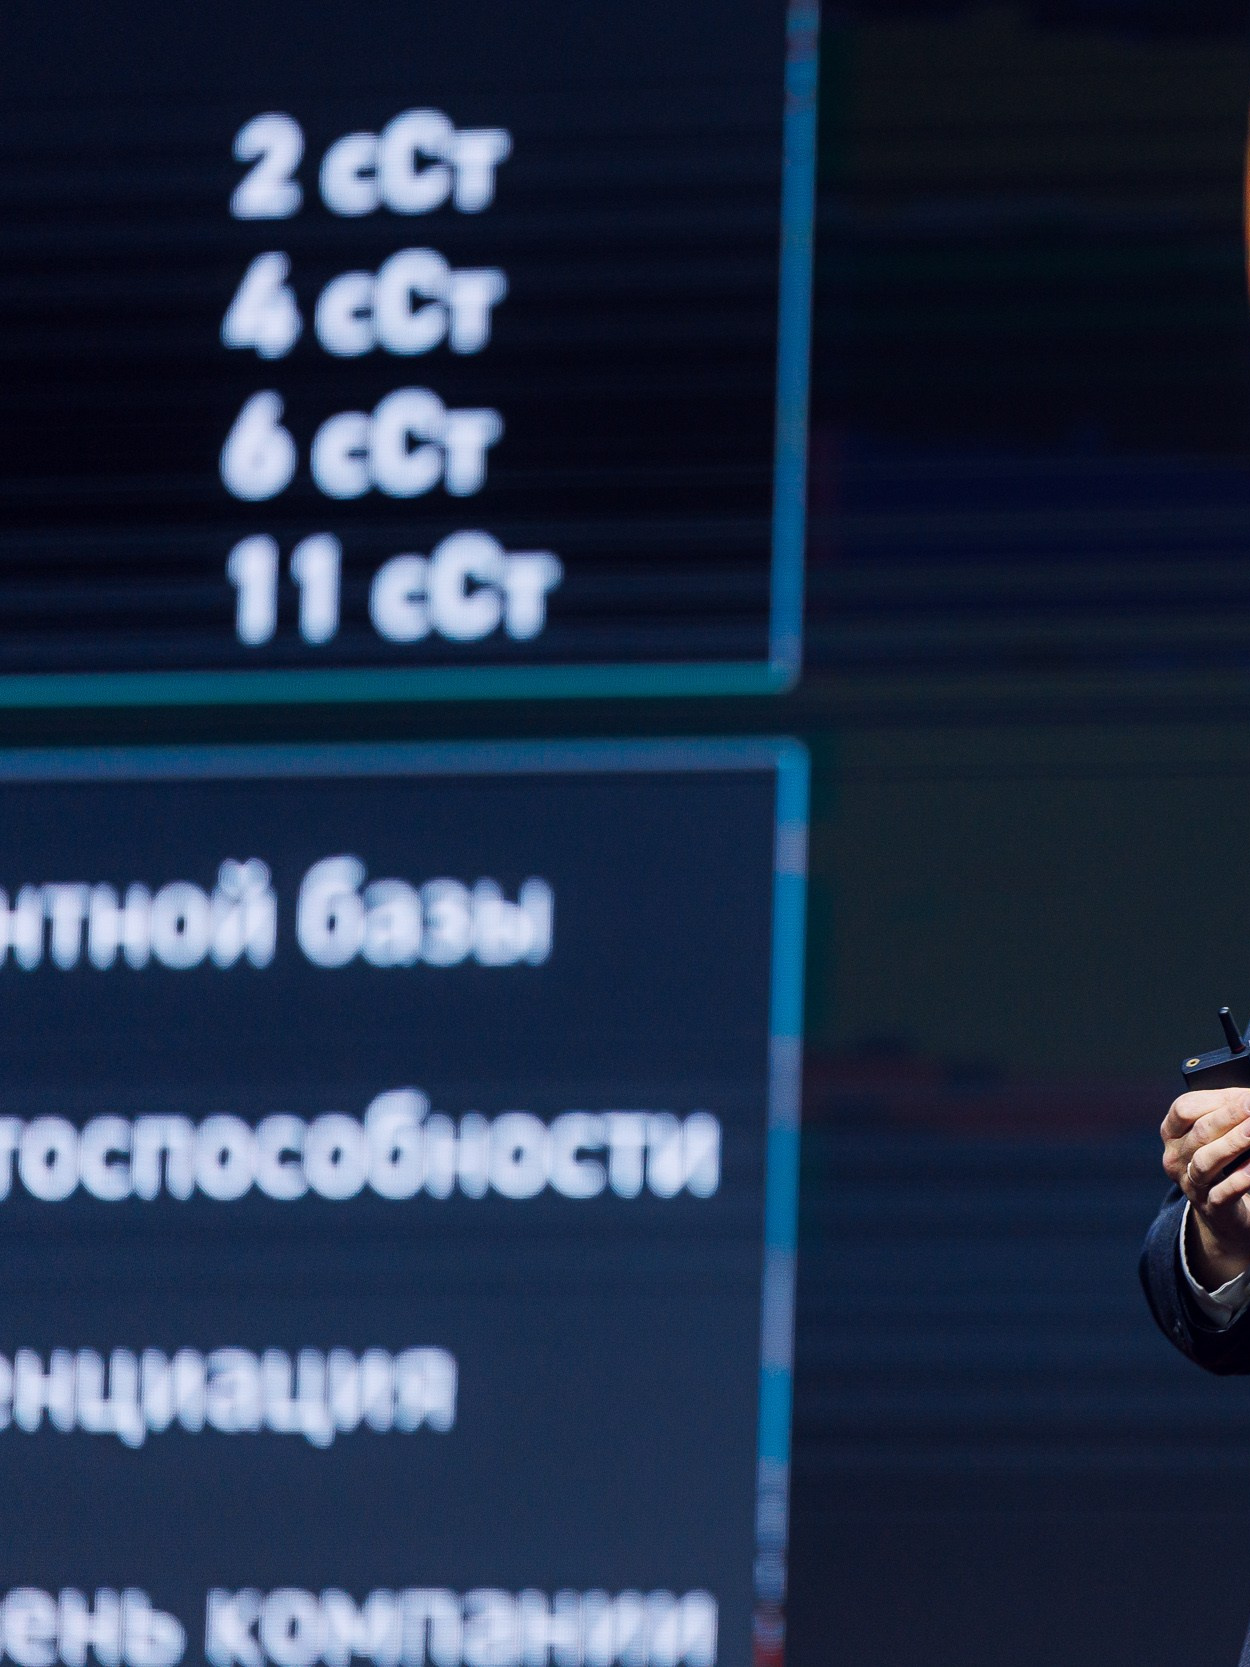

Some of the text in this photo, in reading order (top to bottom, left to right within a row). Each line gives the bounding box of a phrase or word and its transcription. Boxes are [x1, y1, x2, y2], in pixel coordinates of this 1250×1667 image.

[232, 109, 511, 218] 2 сСт
[222, 248, 505, 358] 4 сСт
[221, 388, 502, 500] 6 сСт
[228, 530, 562, 645] 11 сСт
[296, 855, 554, 967] базы
[0, 1347, 458, 1448] нциация
[205, 1587, 718, 1667] компании
